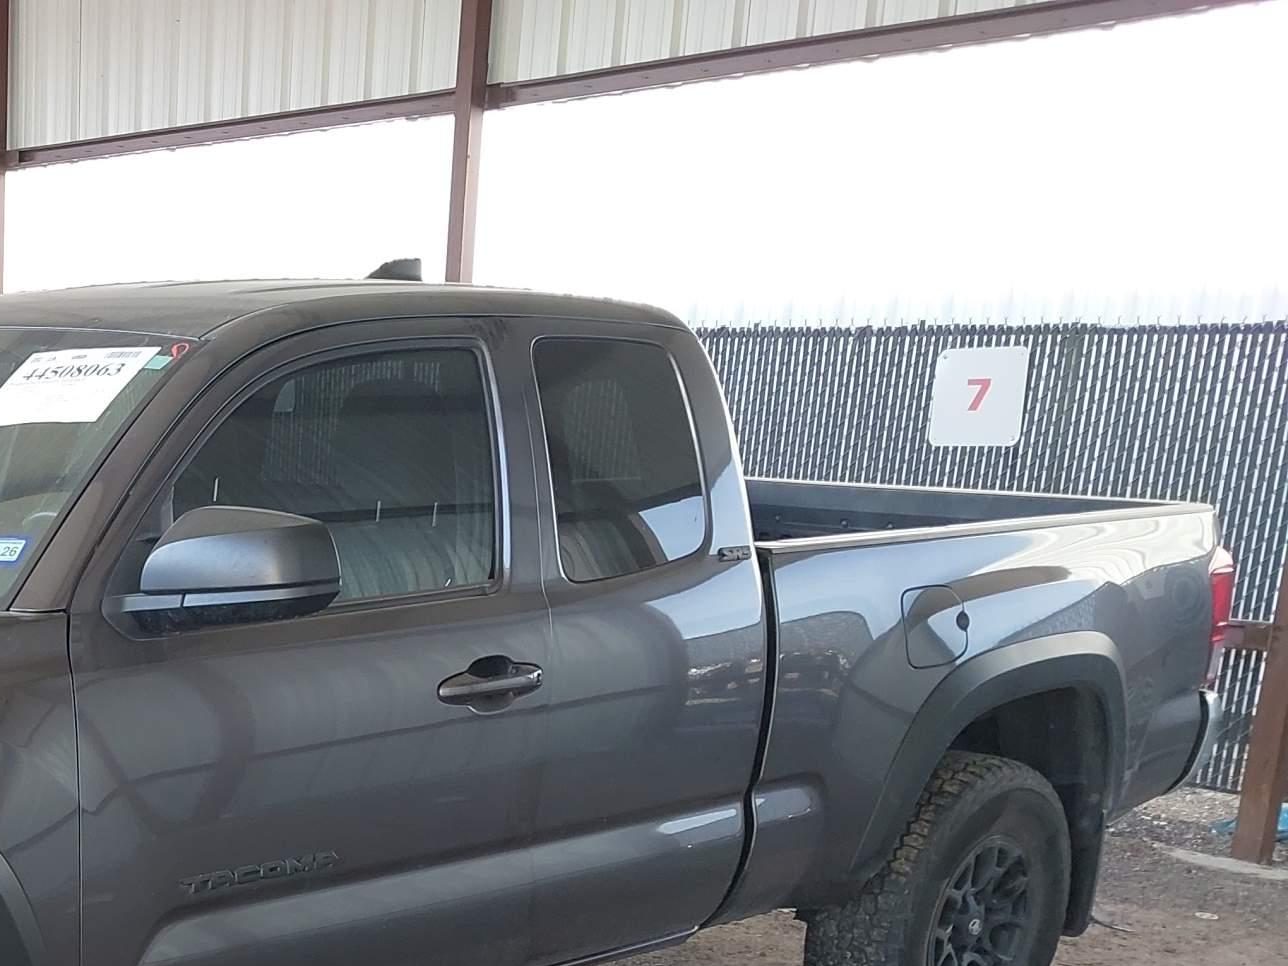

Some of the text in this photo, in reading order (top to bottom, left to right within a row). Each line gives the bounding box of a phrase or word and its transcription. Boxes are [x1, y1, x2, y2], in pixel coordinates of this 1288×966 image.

[23, 362, 127, 382] 44508063
[967, 378, 992, 411] 7
[0, 545, 20, 557] 26
[178, 850, 340, 894] TACOMA
